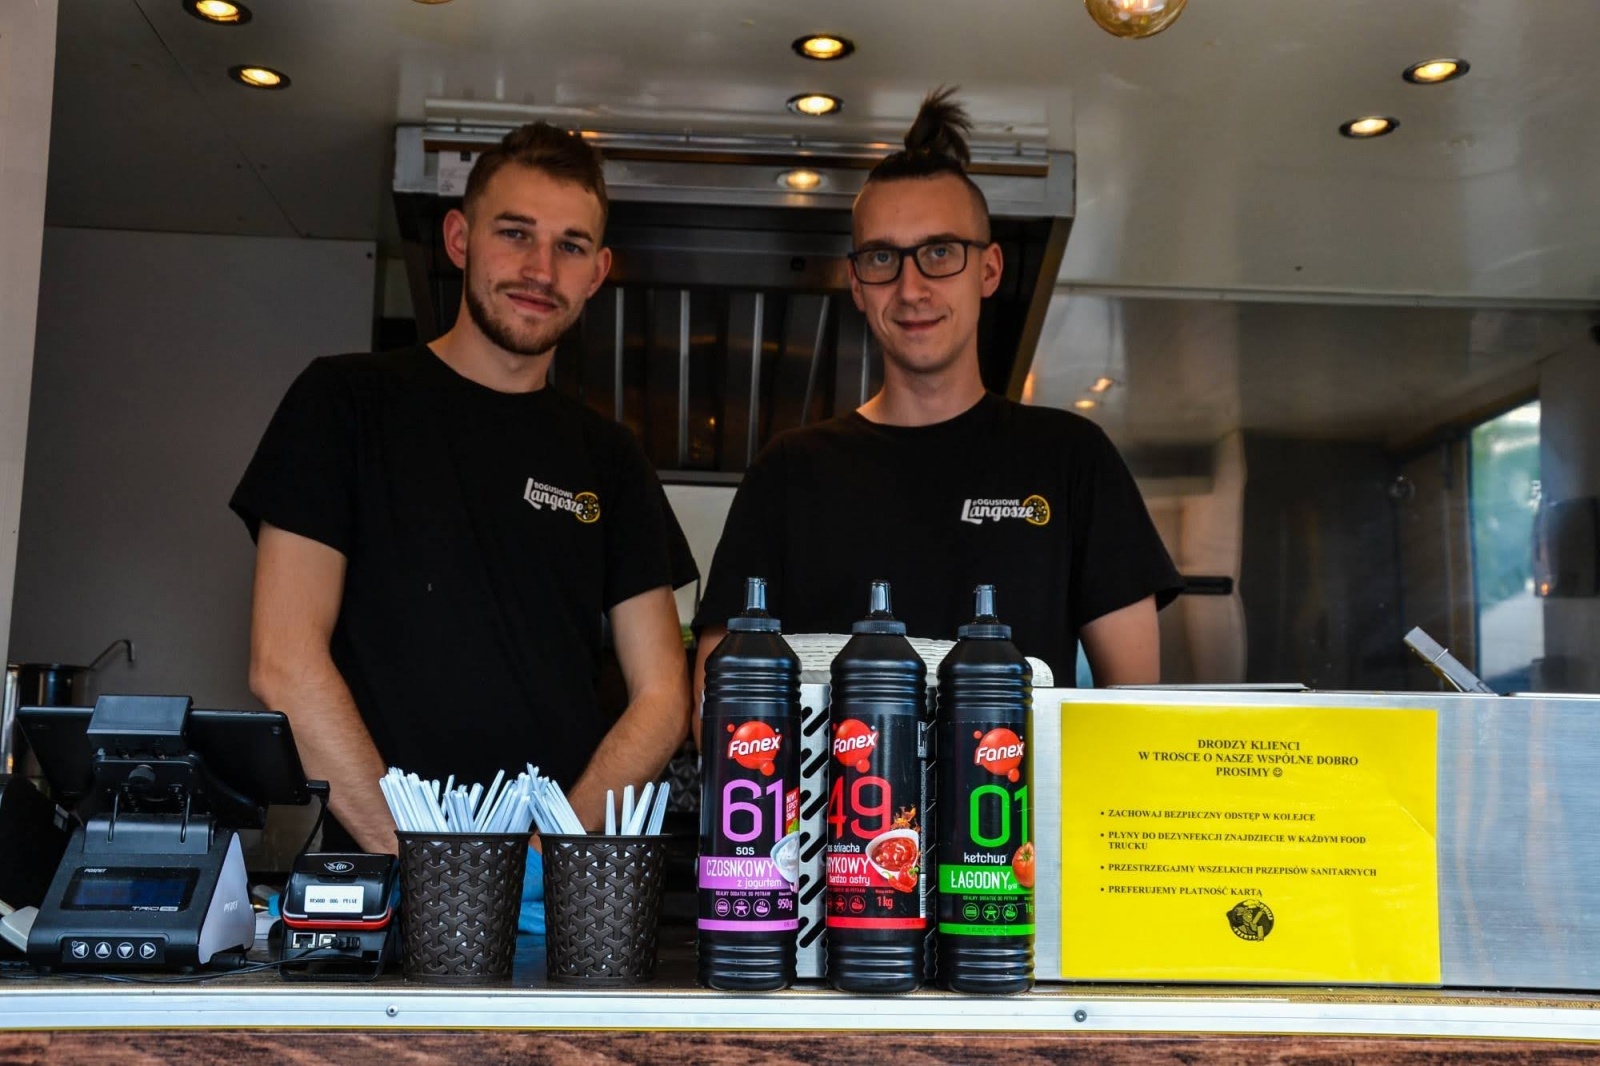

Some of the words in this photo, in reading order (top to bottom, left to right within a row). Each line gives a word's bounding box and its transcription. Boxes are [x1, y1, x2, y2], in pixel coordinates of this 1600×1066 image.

[523, 477, 584, 514] Langosze
[961, 499, 1034, 525] Langosze
[728, 734, 782, 758] Fanex
[833, 731, 878, 756] Fanex
[1198, 739, 1247, 750] DRODZY
[1251, 740, 1300, 751] KLIENCI
[976, 743, 1025, 764] Fanex
[1138, 751, 1150, 761] W
[1153, 752, 1200, 762] TROSCE
[1203, 752, 1212, 763] O
[1216, 753, 1254, 763] NASZE
[1257, 752, 1313, 765] WSPÓLNE
[1317, 756, 1359, 766] DOBRO
[1216, 767, 1270, 777] PROSIMY
[722, 778, 783, 842] 61
[828, 775, 892, 840] 49
[969, 784, 1028, 848] 01
[1108, 809, 1162, 818] ZACHOWAJ
[1164, 810, 1222, 819] BEZPIECZNY
[1224, 812, 1260, 822] ODSTĘP
[1262, 812, 1270, 820] W
[1273, 813, 1316, 821] KOLEJCE
[1108, 831, 1140, 839] PŁYNY
[1142, 832, 1156, 840] DO
[1158, 832, 1222, 841] DEZYNFEKCJI
[1224, 833, 1285, 842] ZNAJDZIECIE
[1298, 834, 1338, 843] KAŻDYM
[1340, 836, 1366, 844] FOOD
[735, 846, 755, 856] sos
[1108, 841, 1148, 850] TRUCKU
[963, 852, 1007, 865] ketchup
[706, 859, 775, 878] CZOSNKOWY
[1108, 863, 1196, 873] PRZESTRZEGAJMY
[1198, 865, 1253, 874] WSZELKICH
[1255, 866, 1308, 875] PRZEPISÓW
[1311, 867, 1377, 877] SANITARNYCH
[737, 880, 742, 888] z
[744, 878, 782, 890] jogurtem
[849, 875, 871, 886] ostry
[950, 870, 1010, 889] ŁAGODNY
[1108, 885, 1176, 894] PREFERUJEMY
[1179, 886, 1229, 896] PŁATNOŚĆ
[777, 898, 793, 910] 950g
